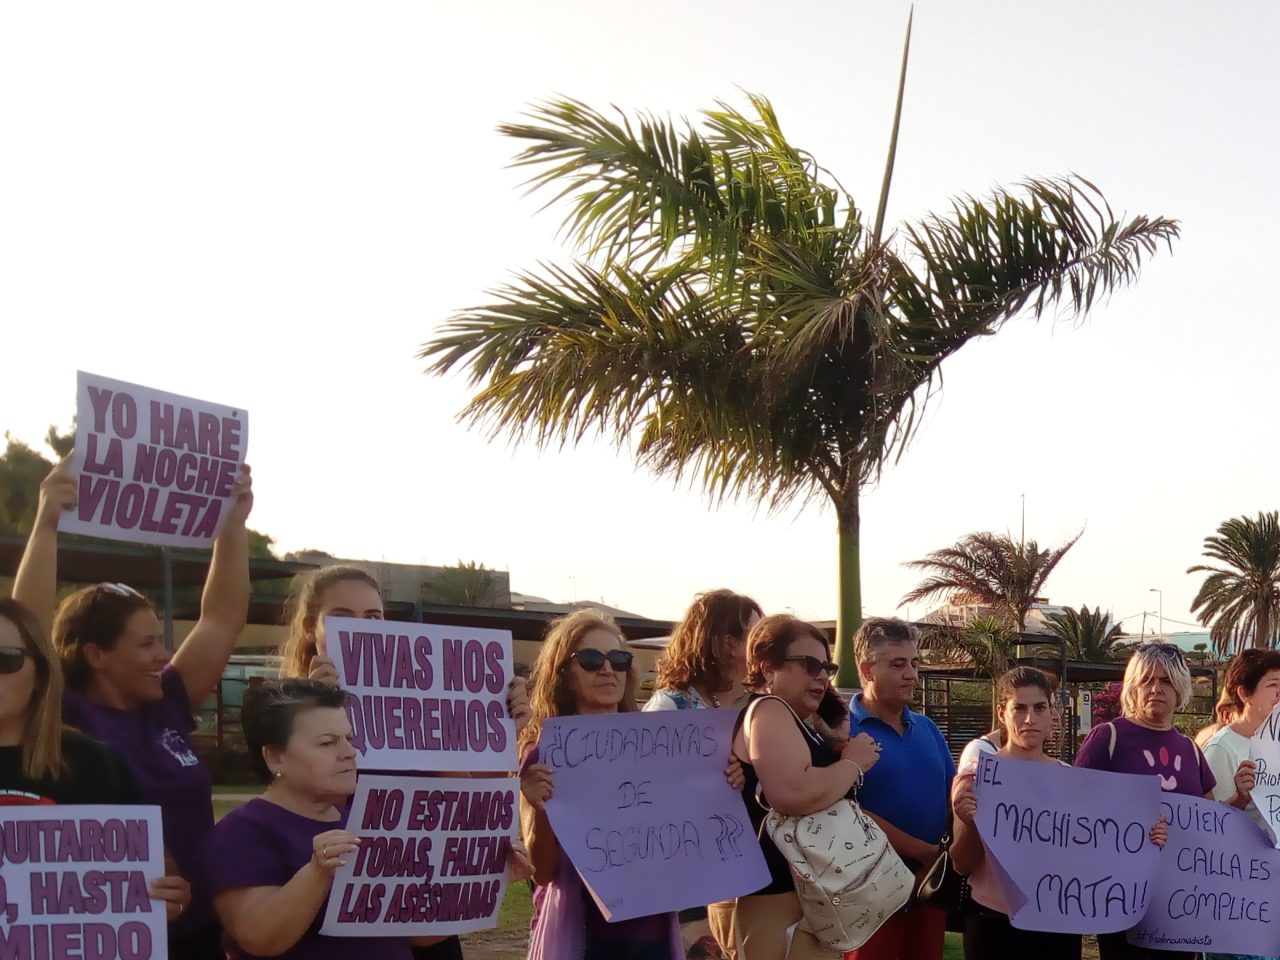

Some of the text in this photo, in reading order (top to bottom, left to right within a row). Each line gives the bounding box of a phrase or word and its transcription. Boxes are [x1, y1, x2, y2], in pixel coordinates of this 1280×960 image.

[87, 386, 241, 461] YO HARÉ
[83, 433, 236, 498] LA NOCHE
[78, 474, 222, 538] VIOLETA
[338, 631, 505, 694] VIVAS NOS
[345, 694, 507, 757] QUEREMOS
[361, 789, 514, 831] NO ESTAMOS
[617, 781, 652, 809] DE
[0, 818, 149, 867] UITARON
[353, 836, 511, 884] TODAS, FALTAN
[1177, 848, 1271, 881] CALLA ES
[30, 870, 152, 915] HASTA
[337, 879, 501, 923] LAS ASESINADAS
